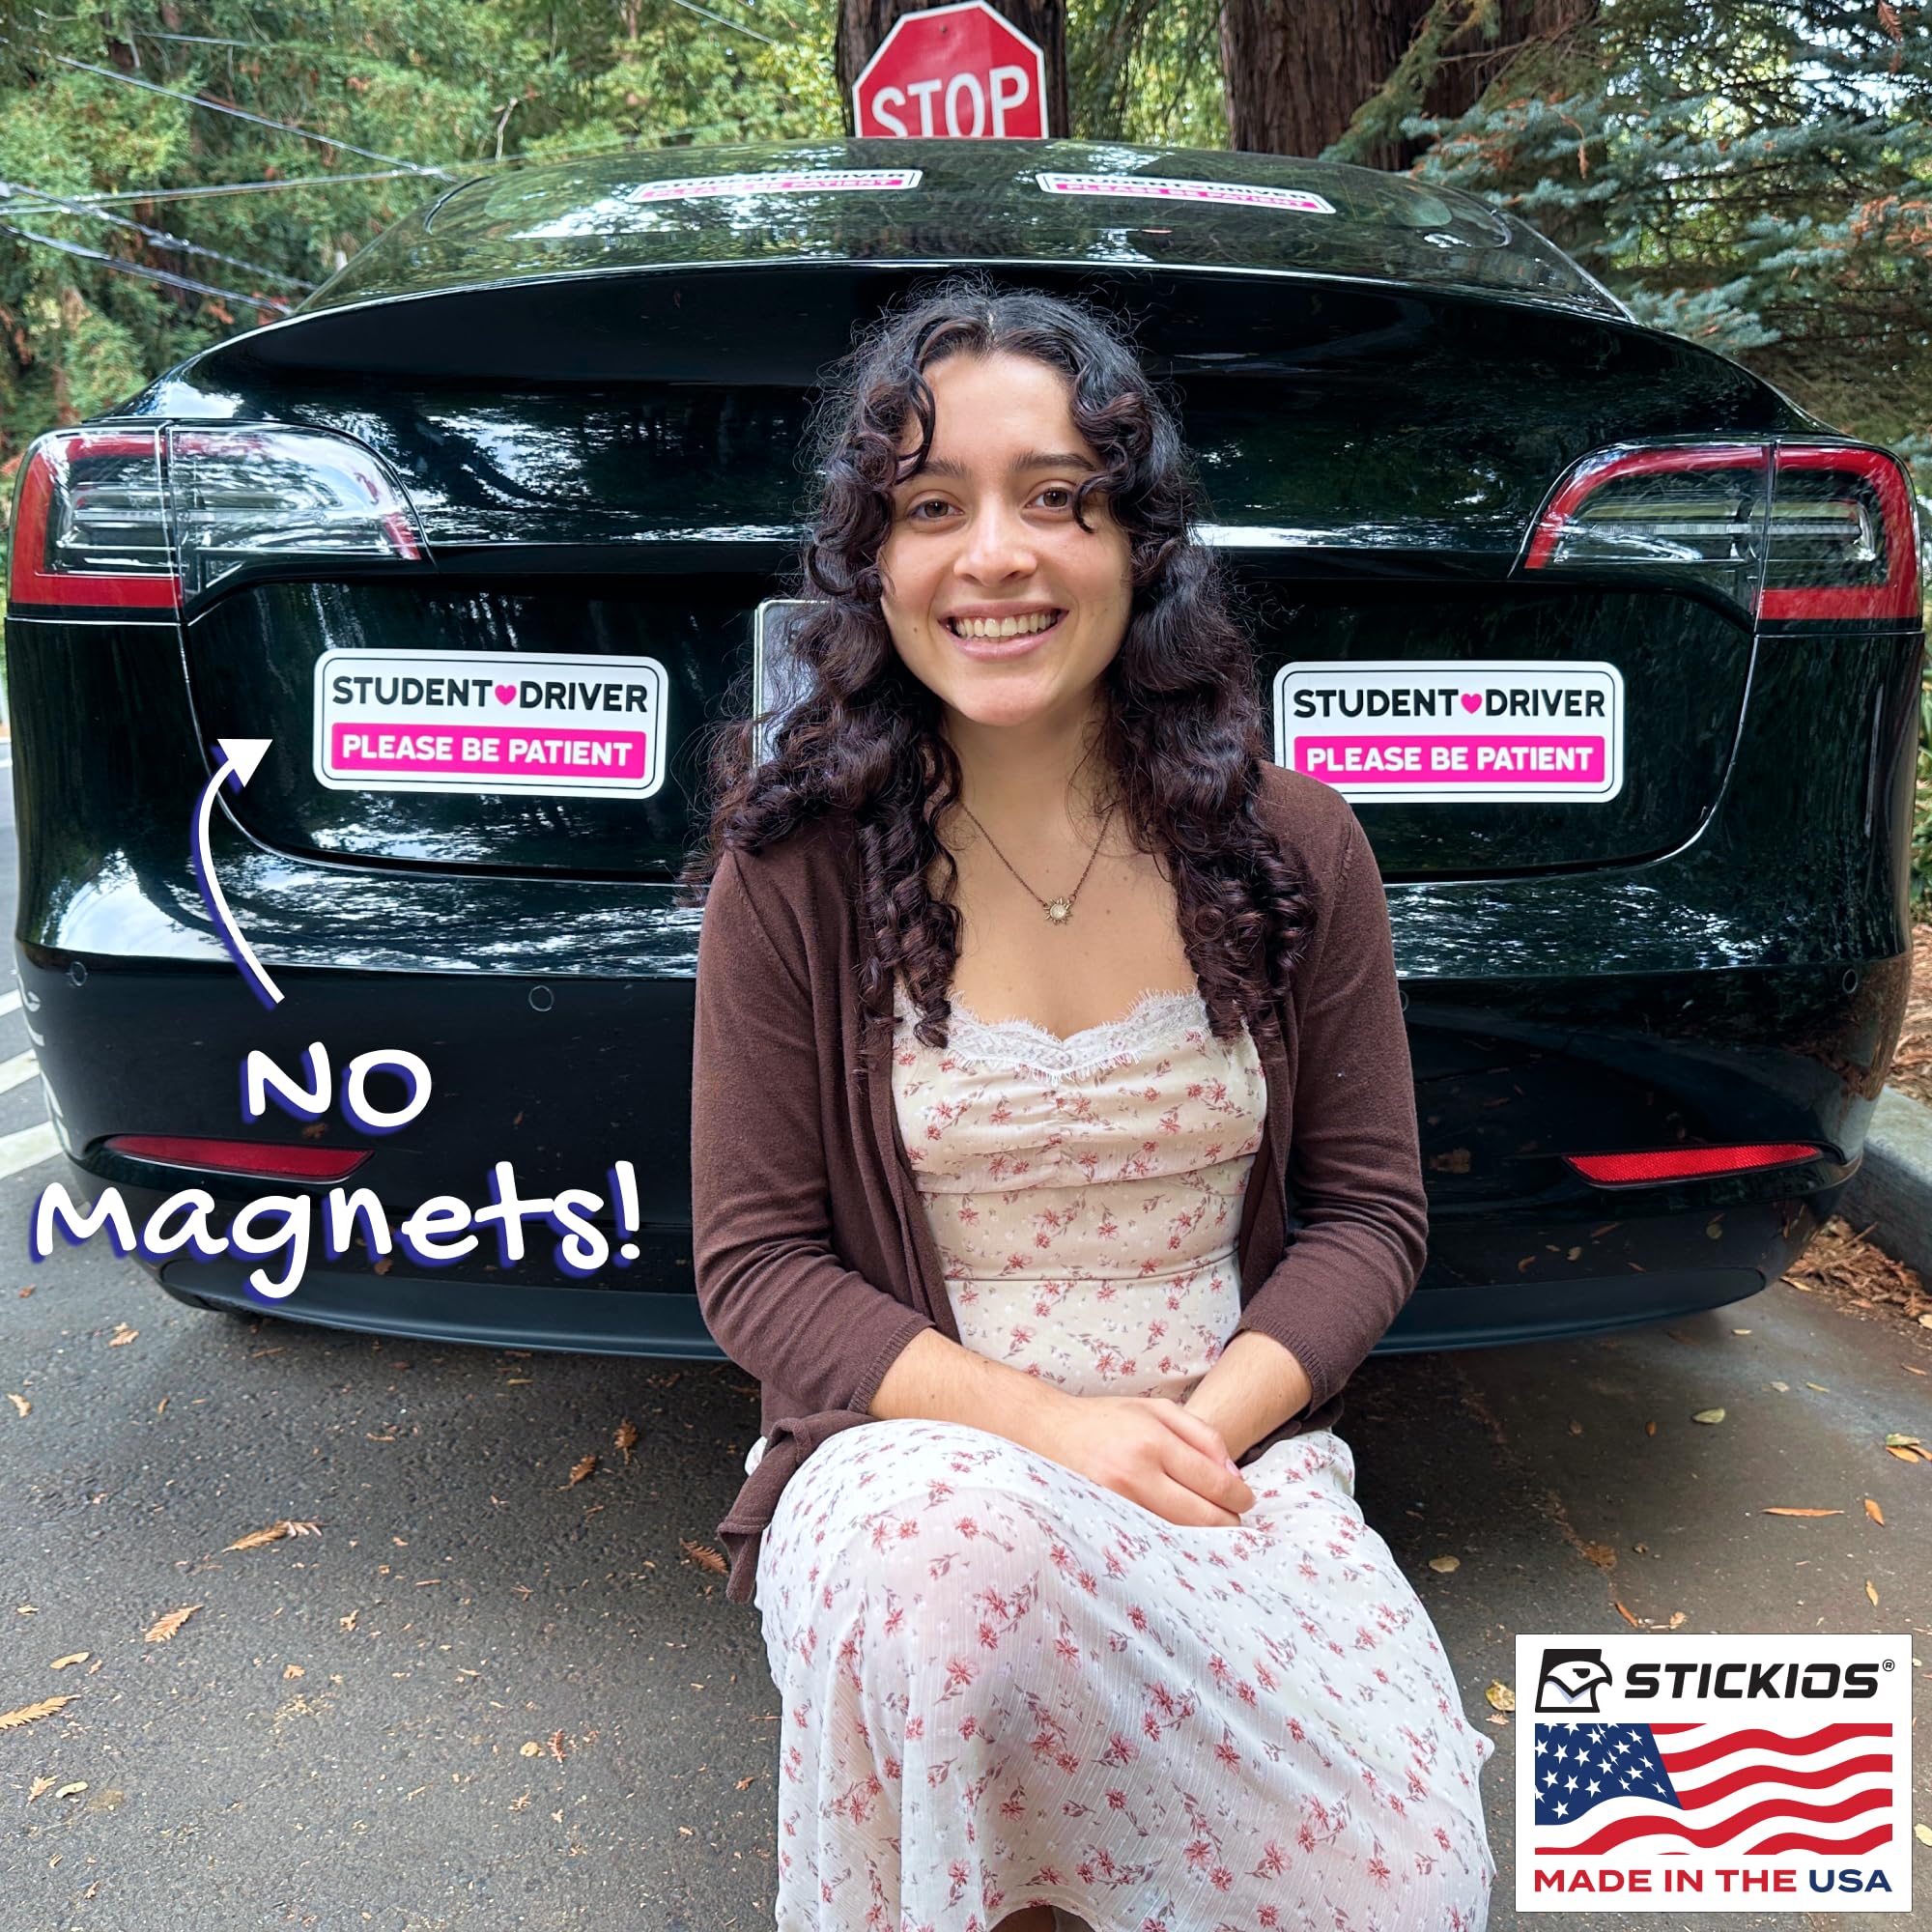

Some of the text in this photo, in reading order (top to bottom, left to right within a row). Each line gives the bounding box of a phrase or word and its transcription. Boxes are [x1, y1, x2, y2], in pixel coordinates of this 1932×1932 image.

[872, 65, 1030, 137] STOP
[332, 676, 648, 712] STUDENT DRIVER
[1293, 689, 1605, 717] STUDENT DRIVER
[342, 734, 633, 766] PLEASE BE PATIENT
[1307, 748, 1593, 771] PLEASE BE PATIENT
